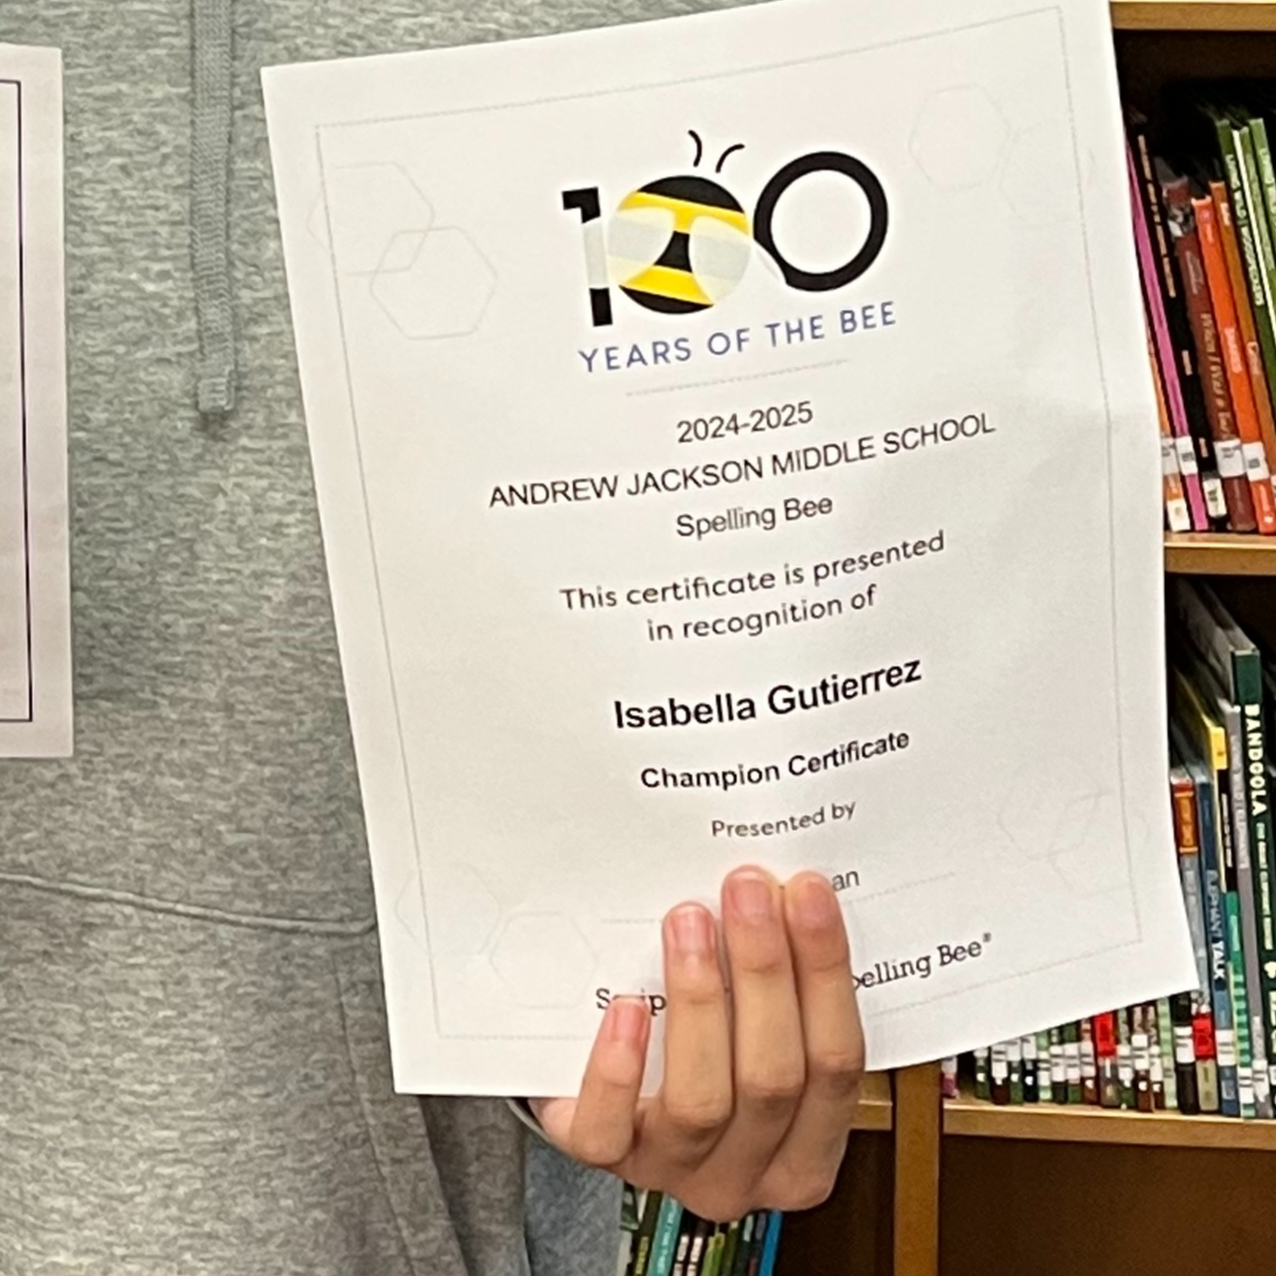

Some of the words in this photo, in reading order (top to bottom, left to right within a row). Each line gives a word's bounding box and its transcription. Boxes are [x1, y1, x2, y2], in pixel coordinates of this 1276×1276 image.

[578, 337, 693, 374] YEARS
[707, 327, 752, 357] OF
[764, 314, 827, 349] THE
[839, 301, 897, 334] BEE
[676, 401, 814, 444] 2024-2025
[489, 475, 620, 509] ANDREW
[625, 456, 764, 498] JACKSON
[771, 435, 876, 475] MIDDLE
[882, 412, 996, 455] SCHOOL
[675, 504, 777, 542] Spelling
[782, 495, 835, 522] Bee
[559, 586, 618, 611] This
[625, 569, 776, 607] certificate
[784, 562, 805, 586] is
[812, 531, 945, 587] presented
[647, 616, 674, 642] in
[681, 599, 843, 638] recognition
[850, 584, 879, 612] of
[614, 691, 757, 730] Isabella
[767, 658, 922, 714] Gutierrez
[640, 763, 781, 791] Champion
[786, 730, 911, 777] Certificate
[1244, 704, 1267, 816] BANDOOLA
[711, 805, 826, 838] Presented
[831, 800, 857, 823] by
[1206, 869, 1223, 938] ELEPHANT
[1211, 940, 1226, 980] TALK
